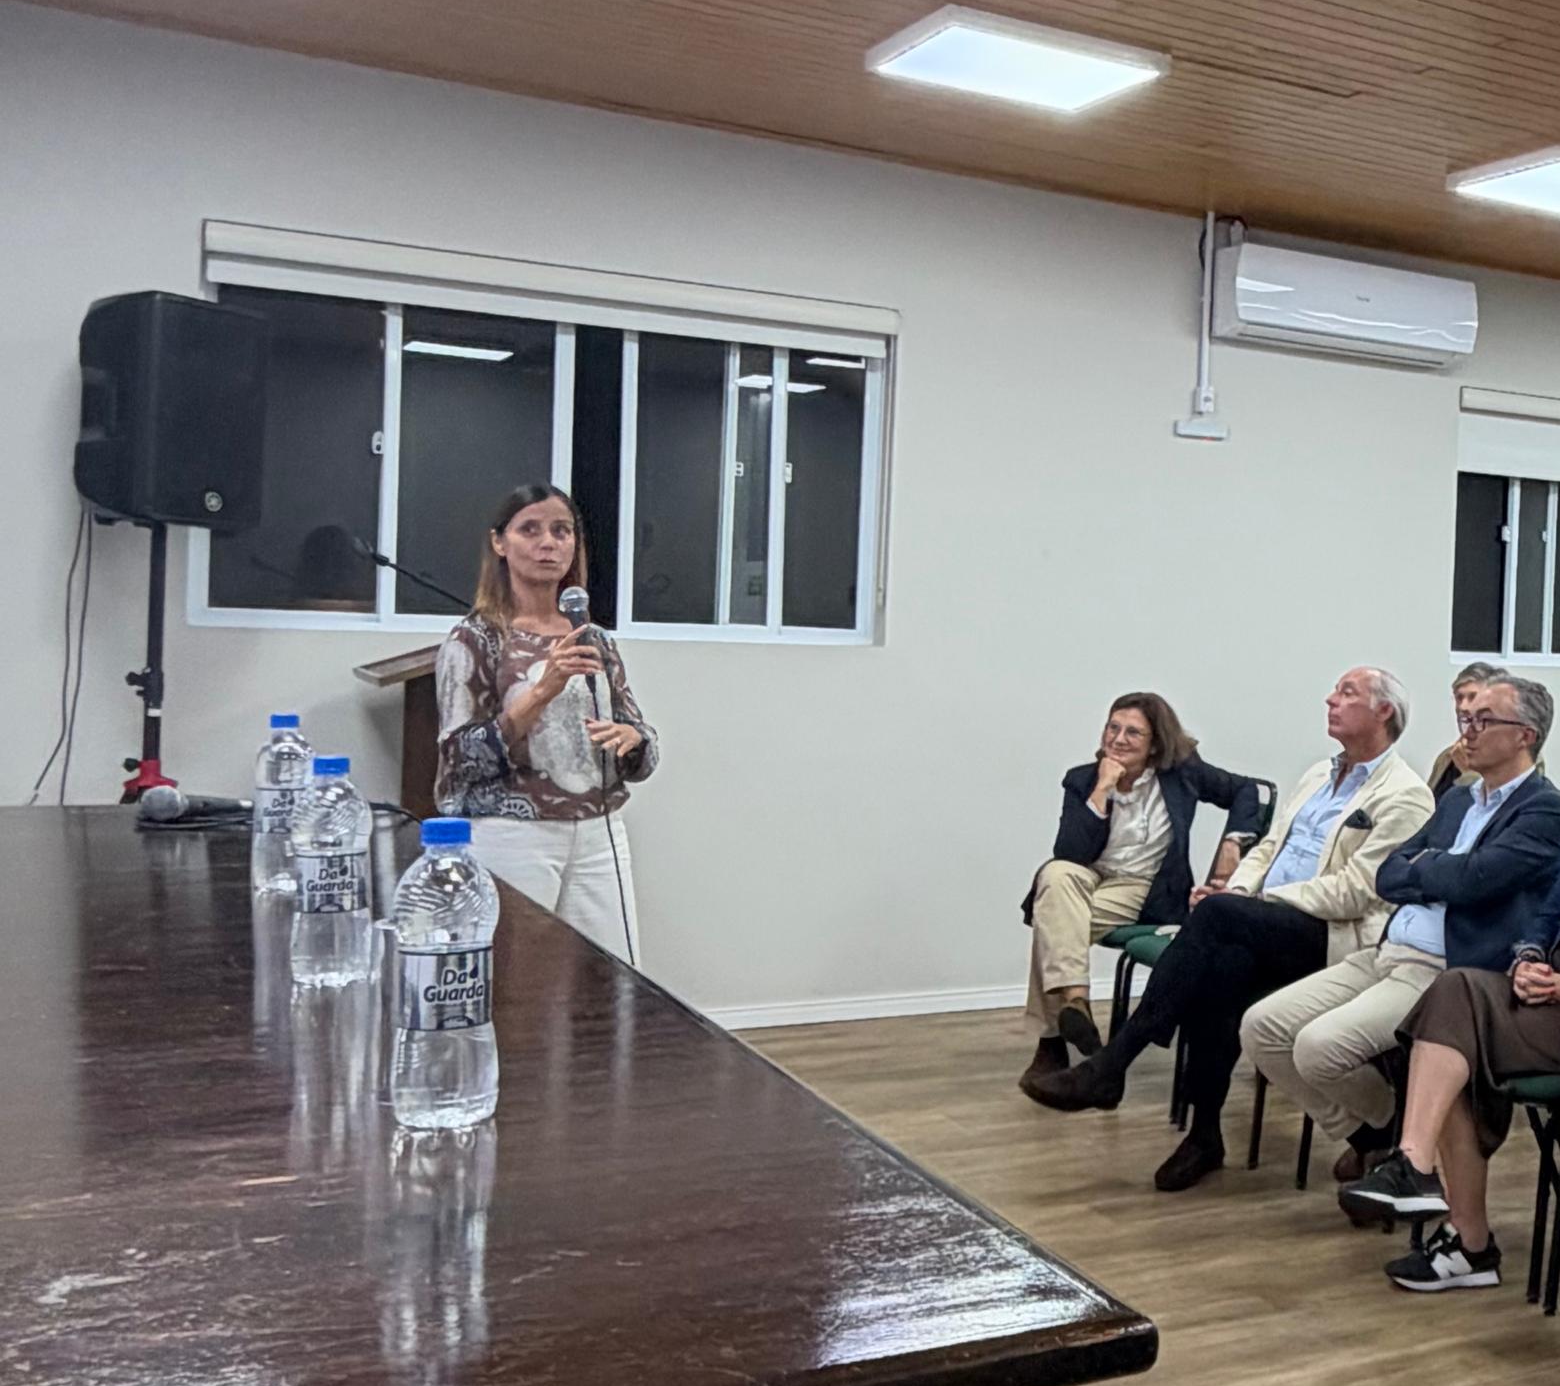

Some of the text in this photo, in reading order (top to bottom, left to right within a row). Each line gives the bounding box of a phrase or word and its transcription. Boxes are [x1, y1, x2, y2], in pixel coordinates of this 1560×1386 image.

[319, 868, 338, 881] Da
[306, 878, 354, 892] Guarda
[443, 969, 468, 985] Da
[423, 981, 484, 1003] Guarda
